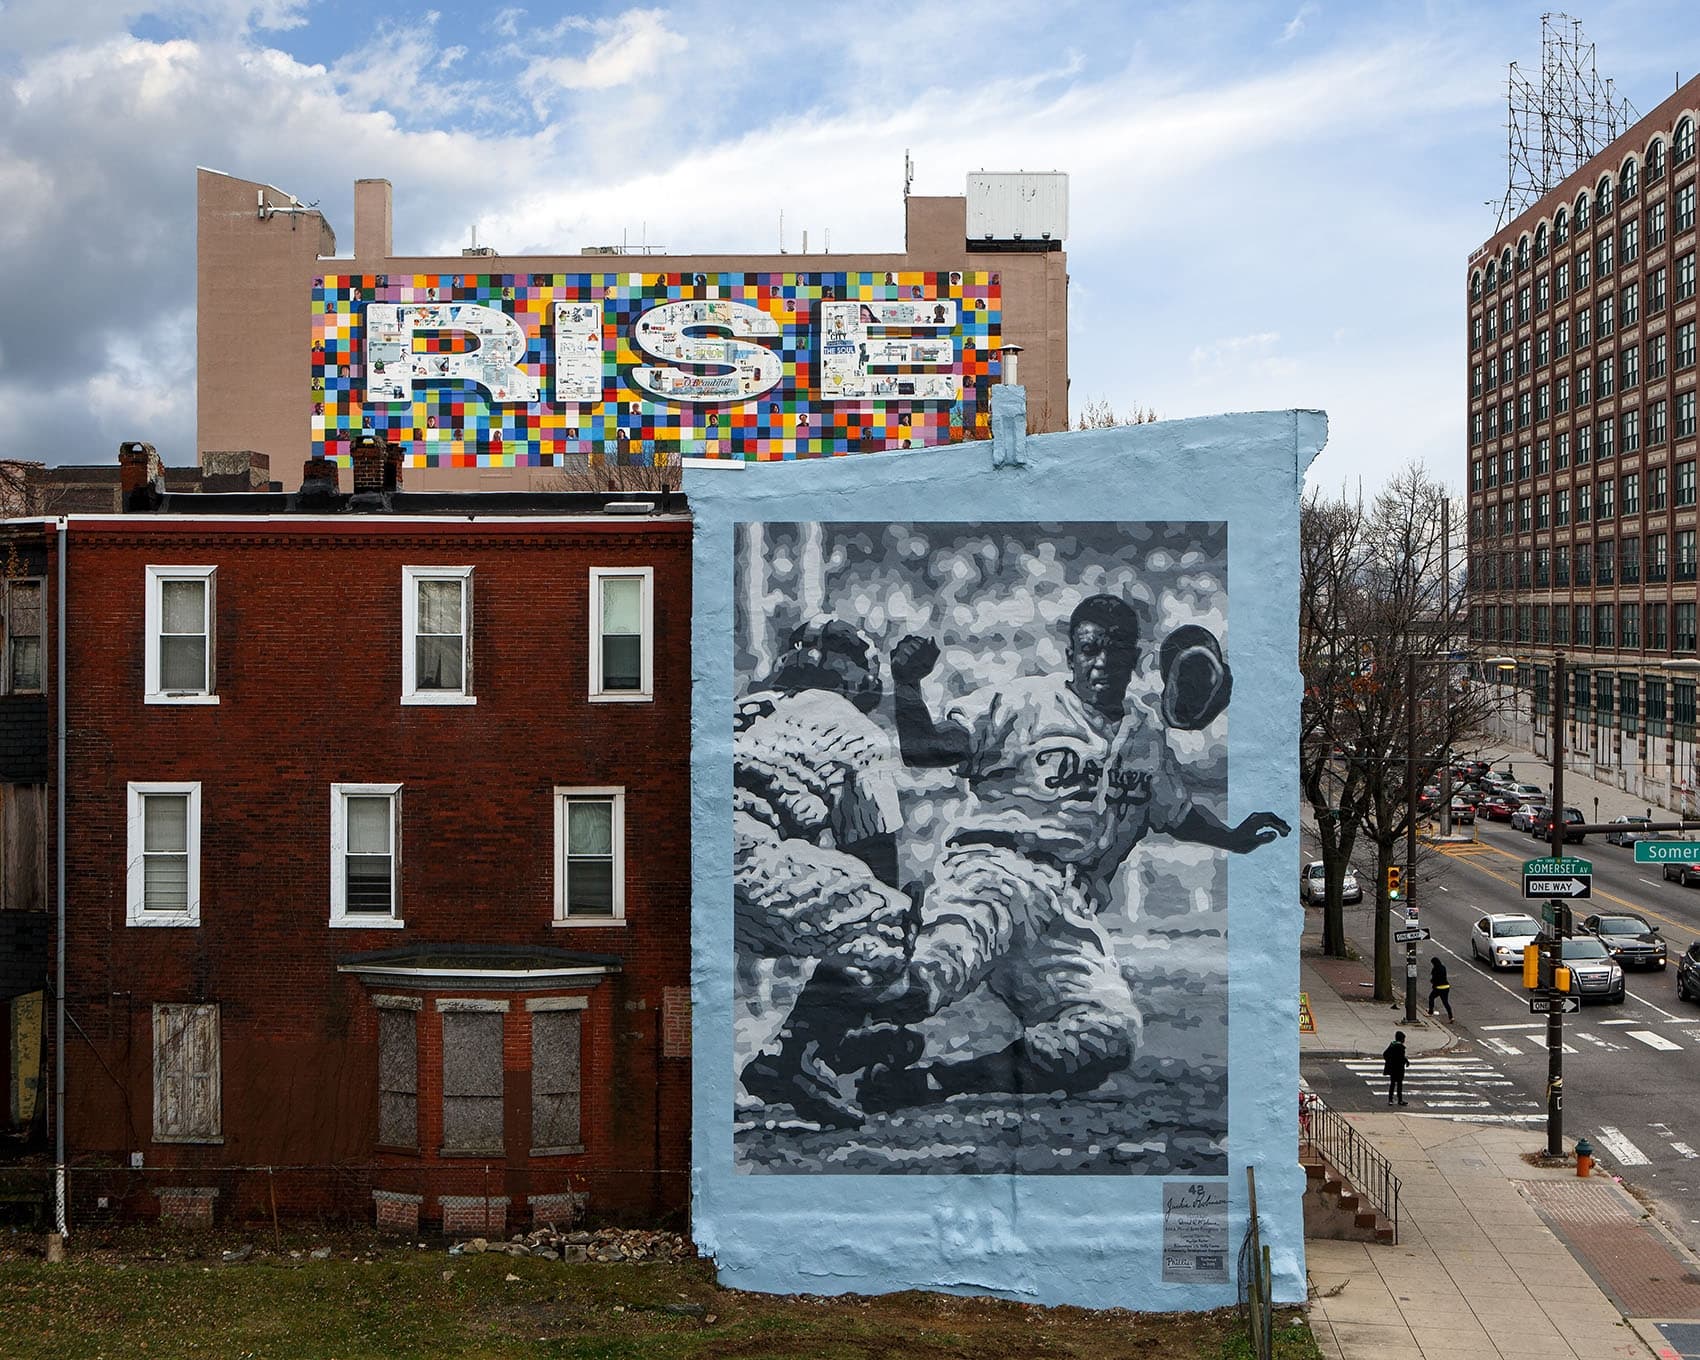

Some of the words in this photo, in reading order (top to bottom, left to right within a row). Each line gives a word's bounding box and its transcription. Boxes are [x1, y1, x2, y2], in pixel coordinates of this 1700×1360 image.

[366, 300, 958, 402] RISE
[1648, 845, 1700, 859] Somer
[1528, 863, 1576, 874] SOMERSET
[1531, 882, 1550, 891] ONE
[1552, 882, 1573, 891] WAY
[1188, 1184, 1205, 1195] 42
